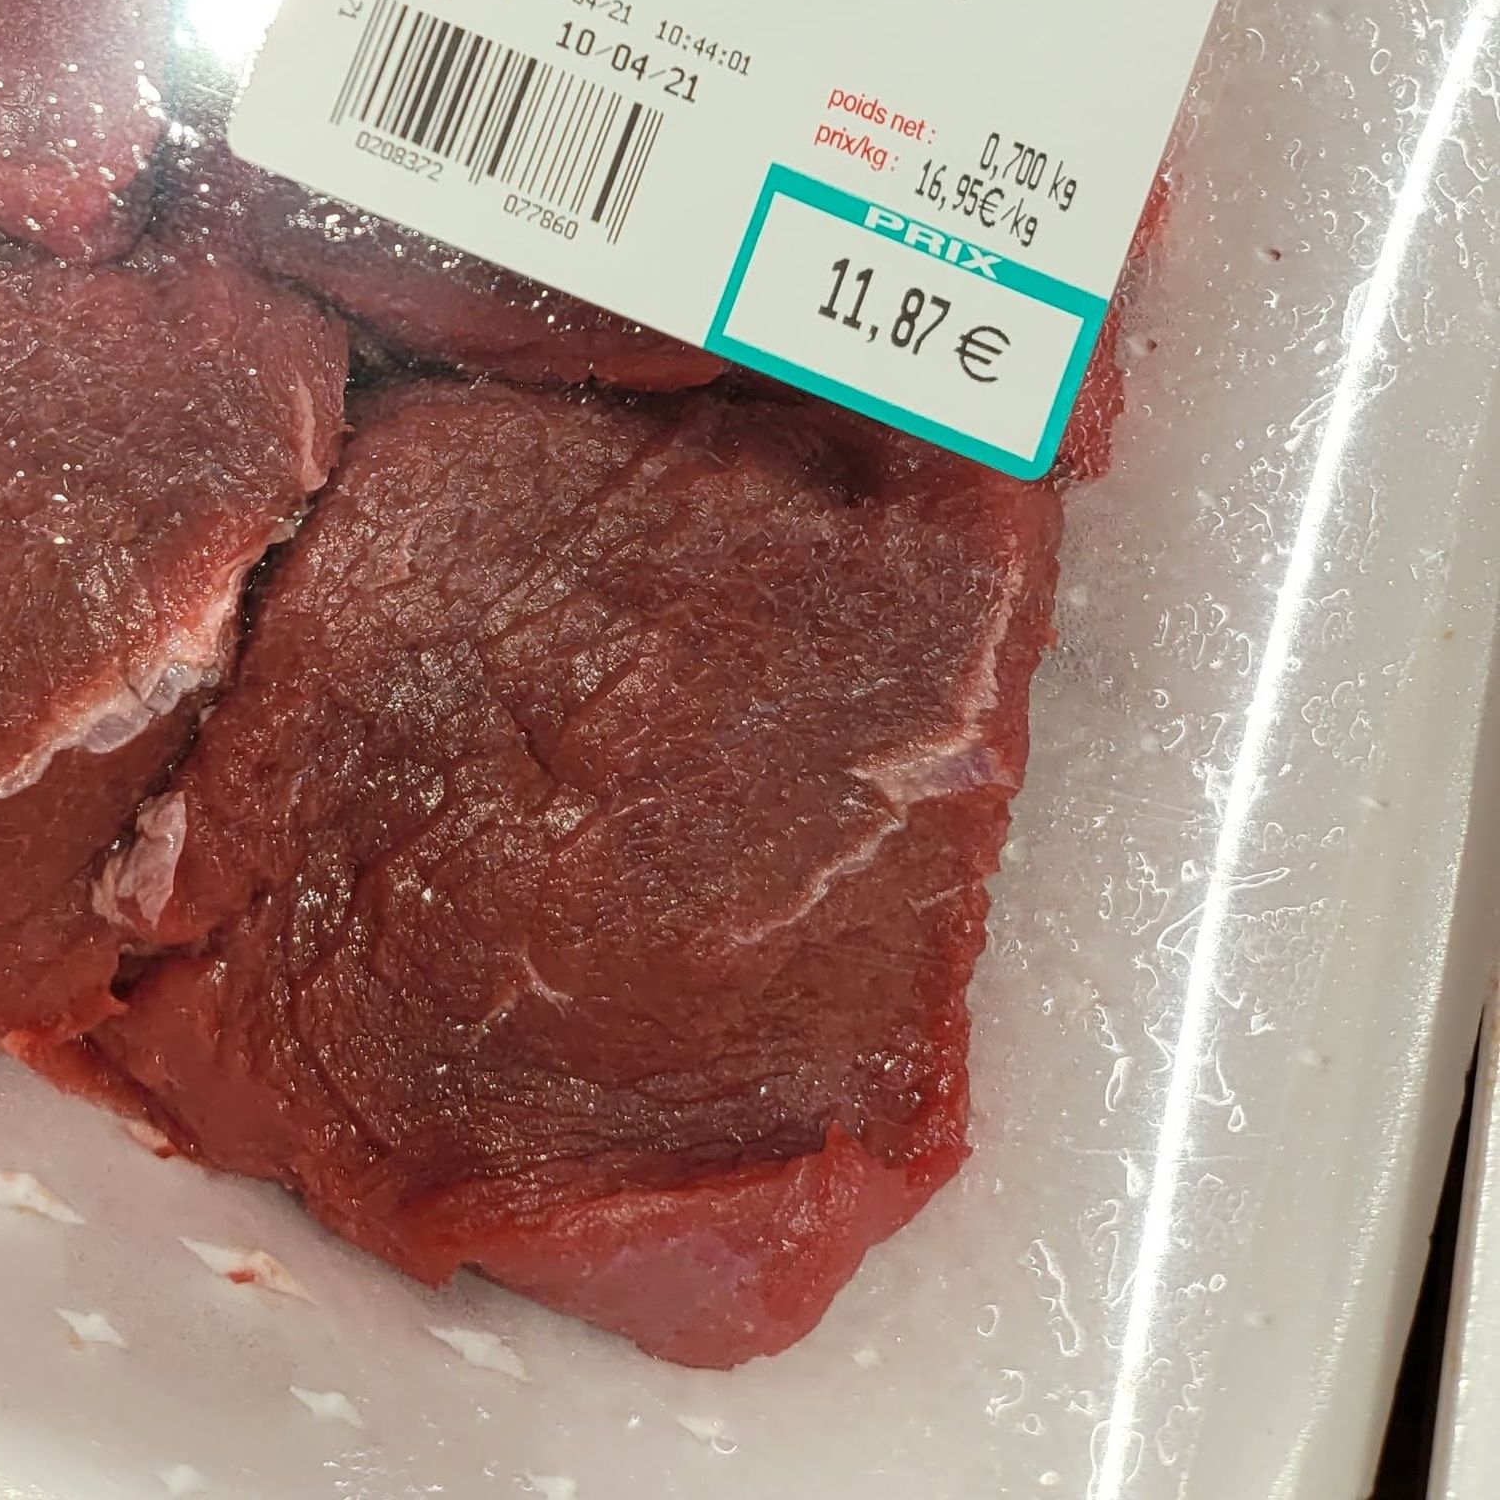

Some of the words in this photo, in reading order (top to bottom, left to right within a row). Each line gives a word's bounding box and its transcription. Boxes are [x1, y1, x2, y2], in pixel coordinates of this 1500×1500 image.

[555, 20, 701, 103] 10/04/21
[655, 20, 752, 76] 10:44:01
[827, 88, 888, 126] poids
[355, 131, 445, 182] 0208372
[503, 193, 580, 241] 077860
[914, 158, 1039, 248] 16,95€/kg
[980, 132, 1048, 192] 0,700
[1048, 160, 1078, 212] kg
[863, 205, 1003, 280] PRIX
[818, 257, 952, 356] 11,87
[954, 325, 1011, 383] €
